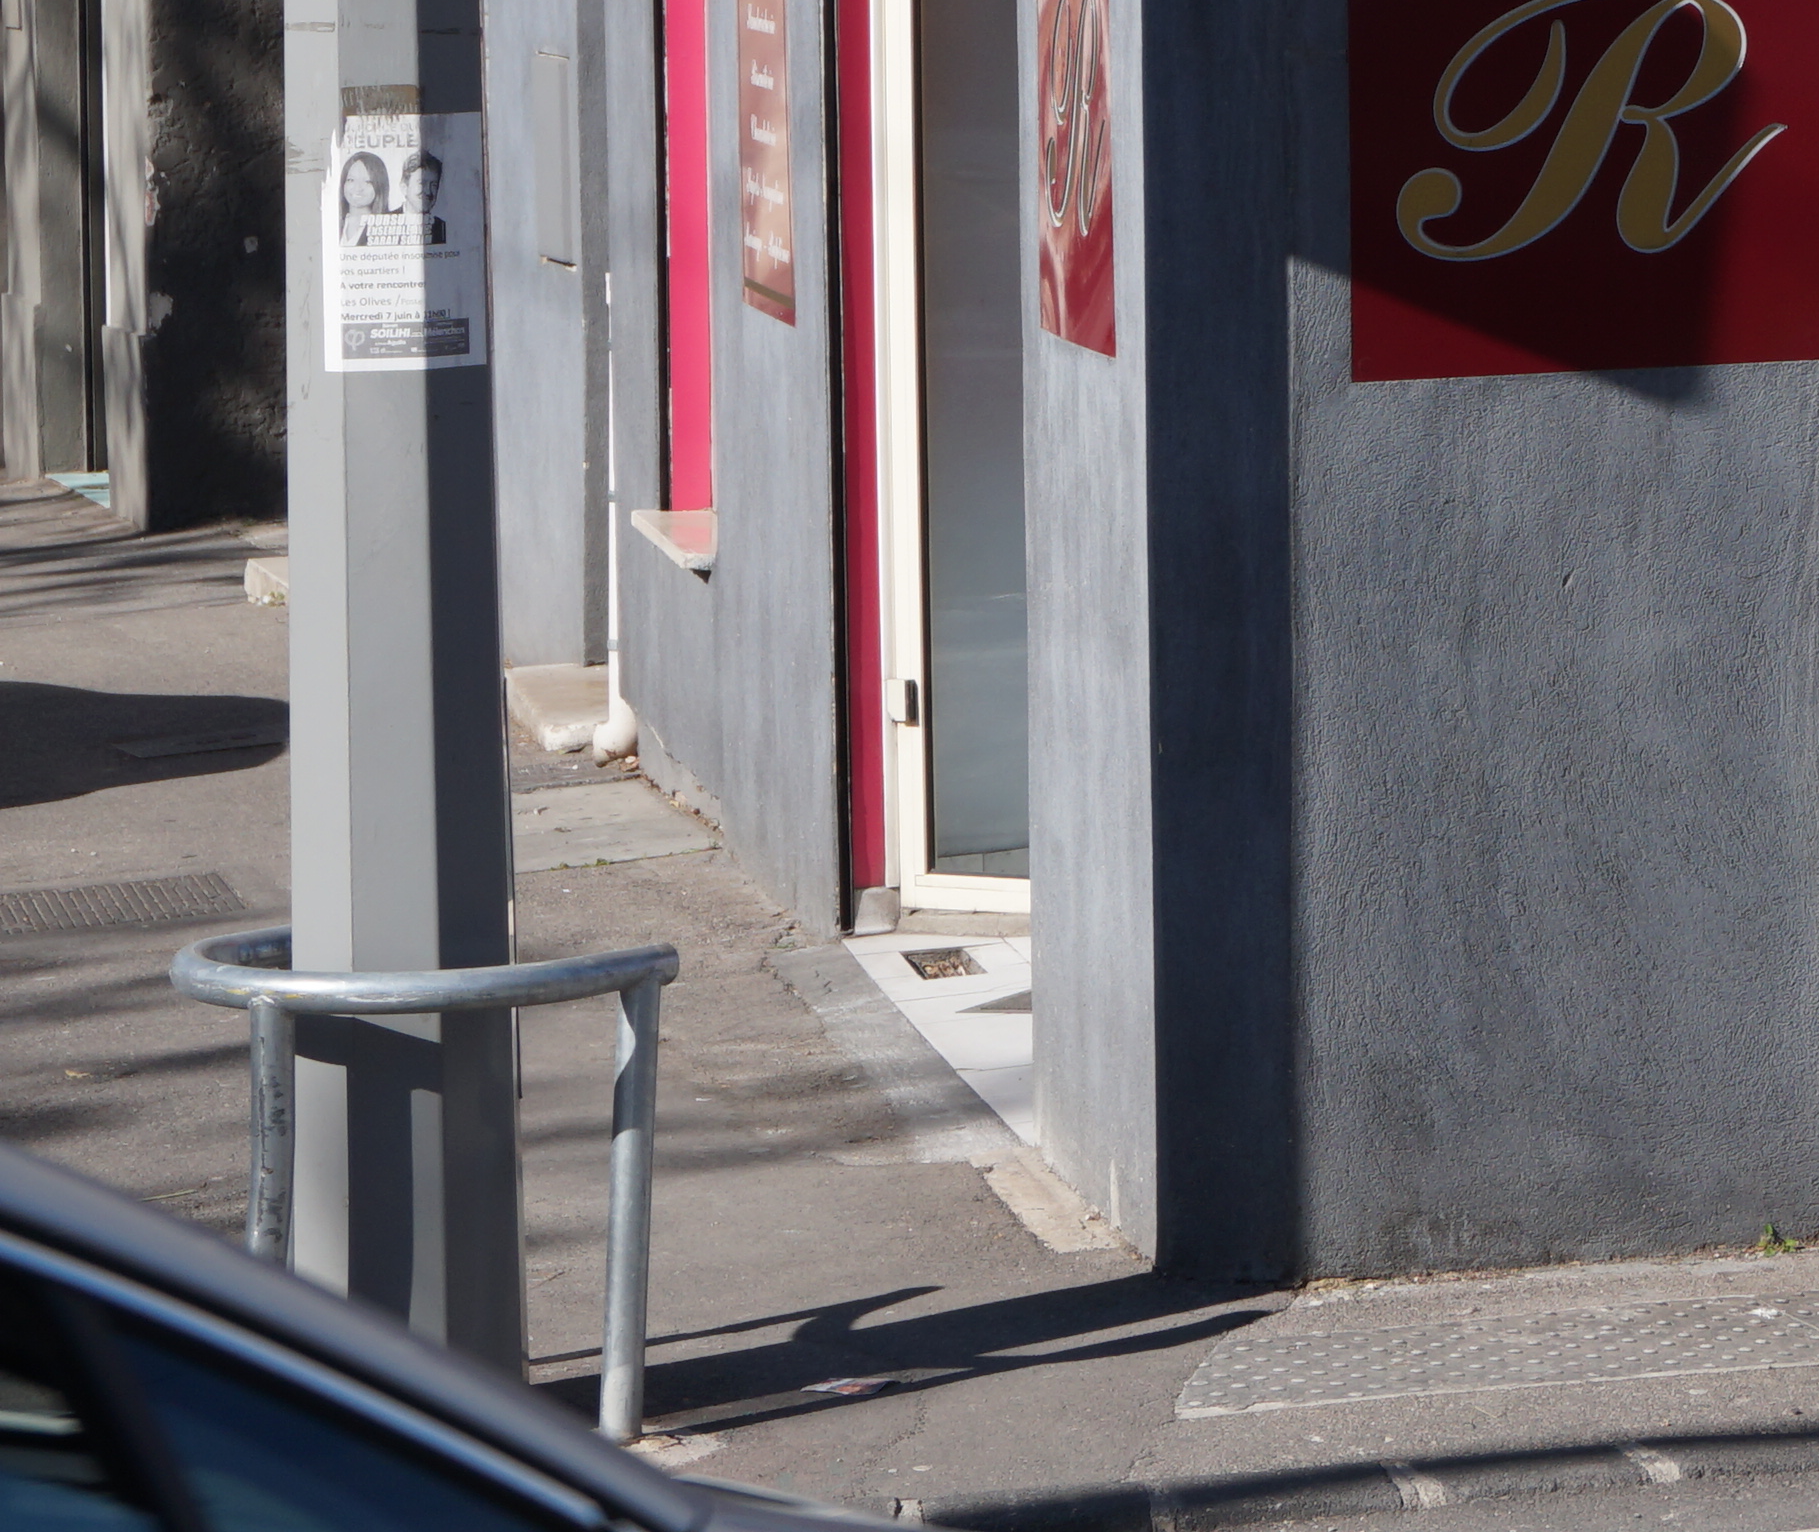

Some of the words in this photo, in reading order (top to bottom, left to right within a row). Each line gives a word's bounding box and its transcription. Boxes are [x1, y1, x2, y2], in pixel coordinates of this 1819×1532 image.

[340, 252, 358, 261] Une
[360, 251, 400, 263] députée
[357, 266, 400, 277] quartiers
[348, 282, 374, 290] votre
[359, 296, 392, 306] Olives
[341, 312, 384, 321] Mercredi
[394, 311, 412, 321] juin
